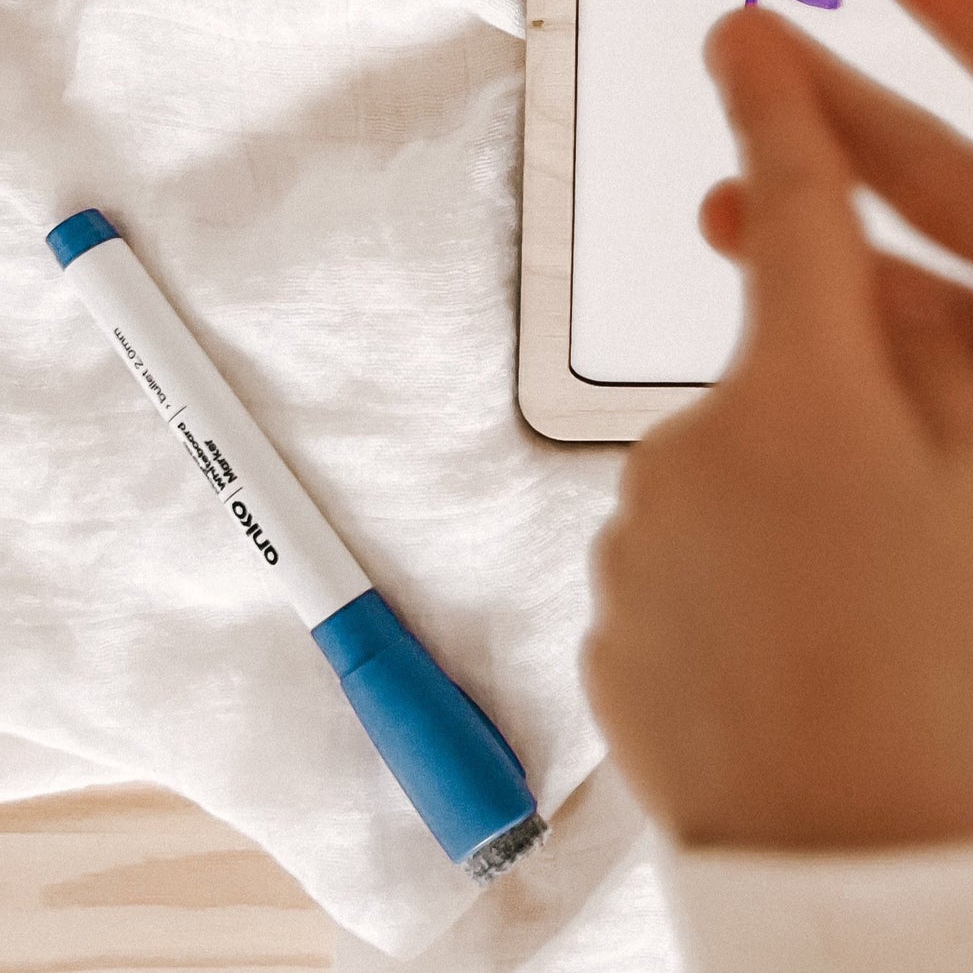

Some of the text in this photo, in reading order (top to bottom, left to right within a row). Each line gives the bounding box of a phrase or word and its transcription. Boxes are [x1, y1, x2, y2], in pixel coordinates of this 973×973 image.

[141, 368, 167, 405] bullet
[177, 421, 227, 492] Whiteboard
[204, 438, 238, 485] Marker
[231, 500, 279, 566] anko
